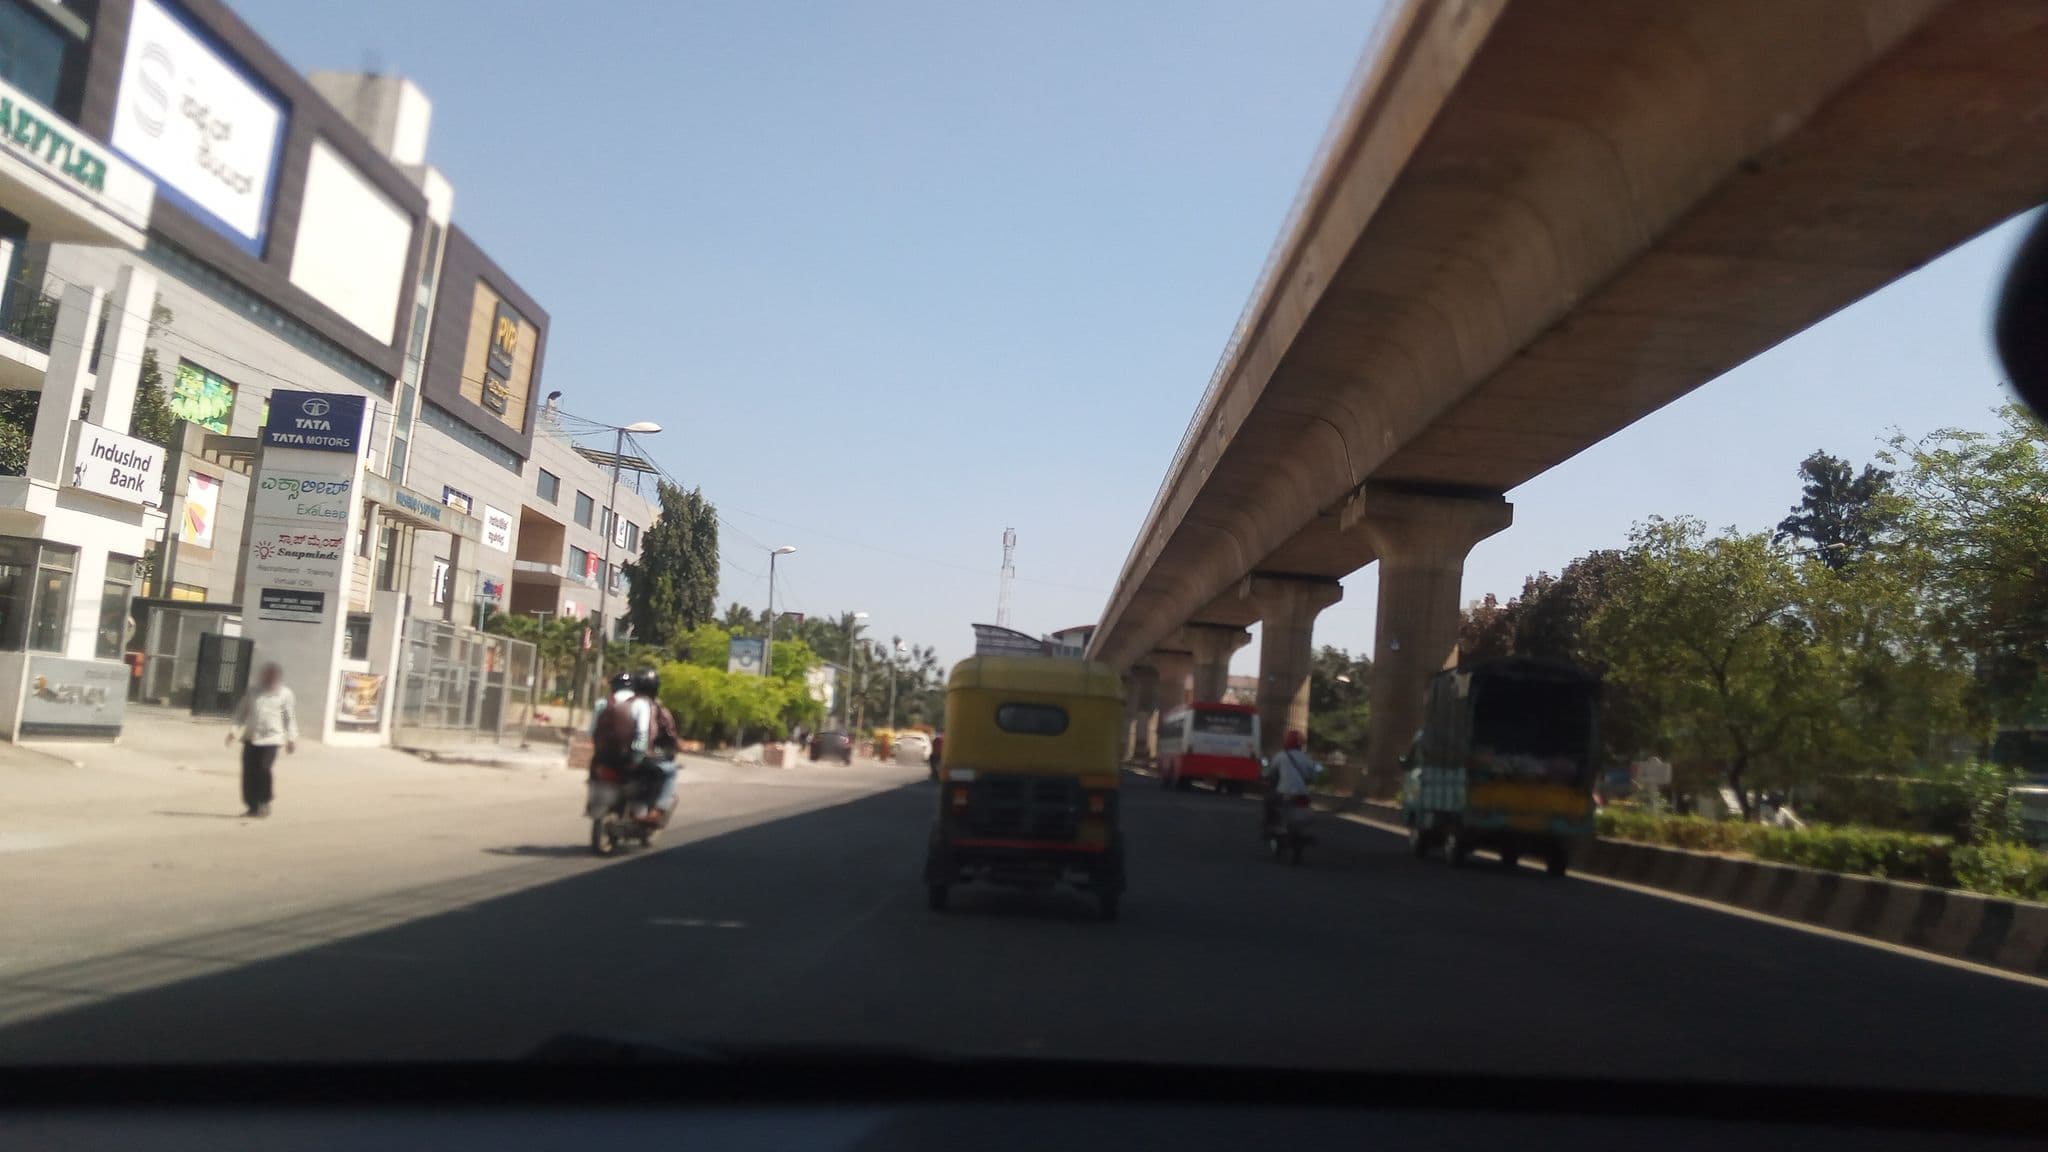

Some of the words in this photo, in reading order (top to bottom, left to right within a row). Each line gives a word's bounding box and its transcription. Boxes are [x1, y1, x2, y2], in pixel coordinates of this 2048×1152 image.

[295, 418, 331, 431] TATA
[271, 432, 305, 444] TATA
[306, 435, 350, 447] MOTORS
[90, 437, 152, 472] IndusInd
[109, 468, 145, 493] Bank
[277, 547, 340, 560] Snapminds
